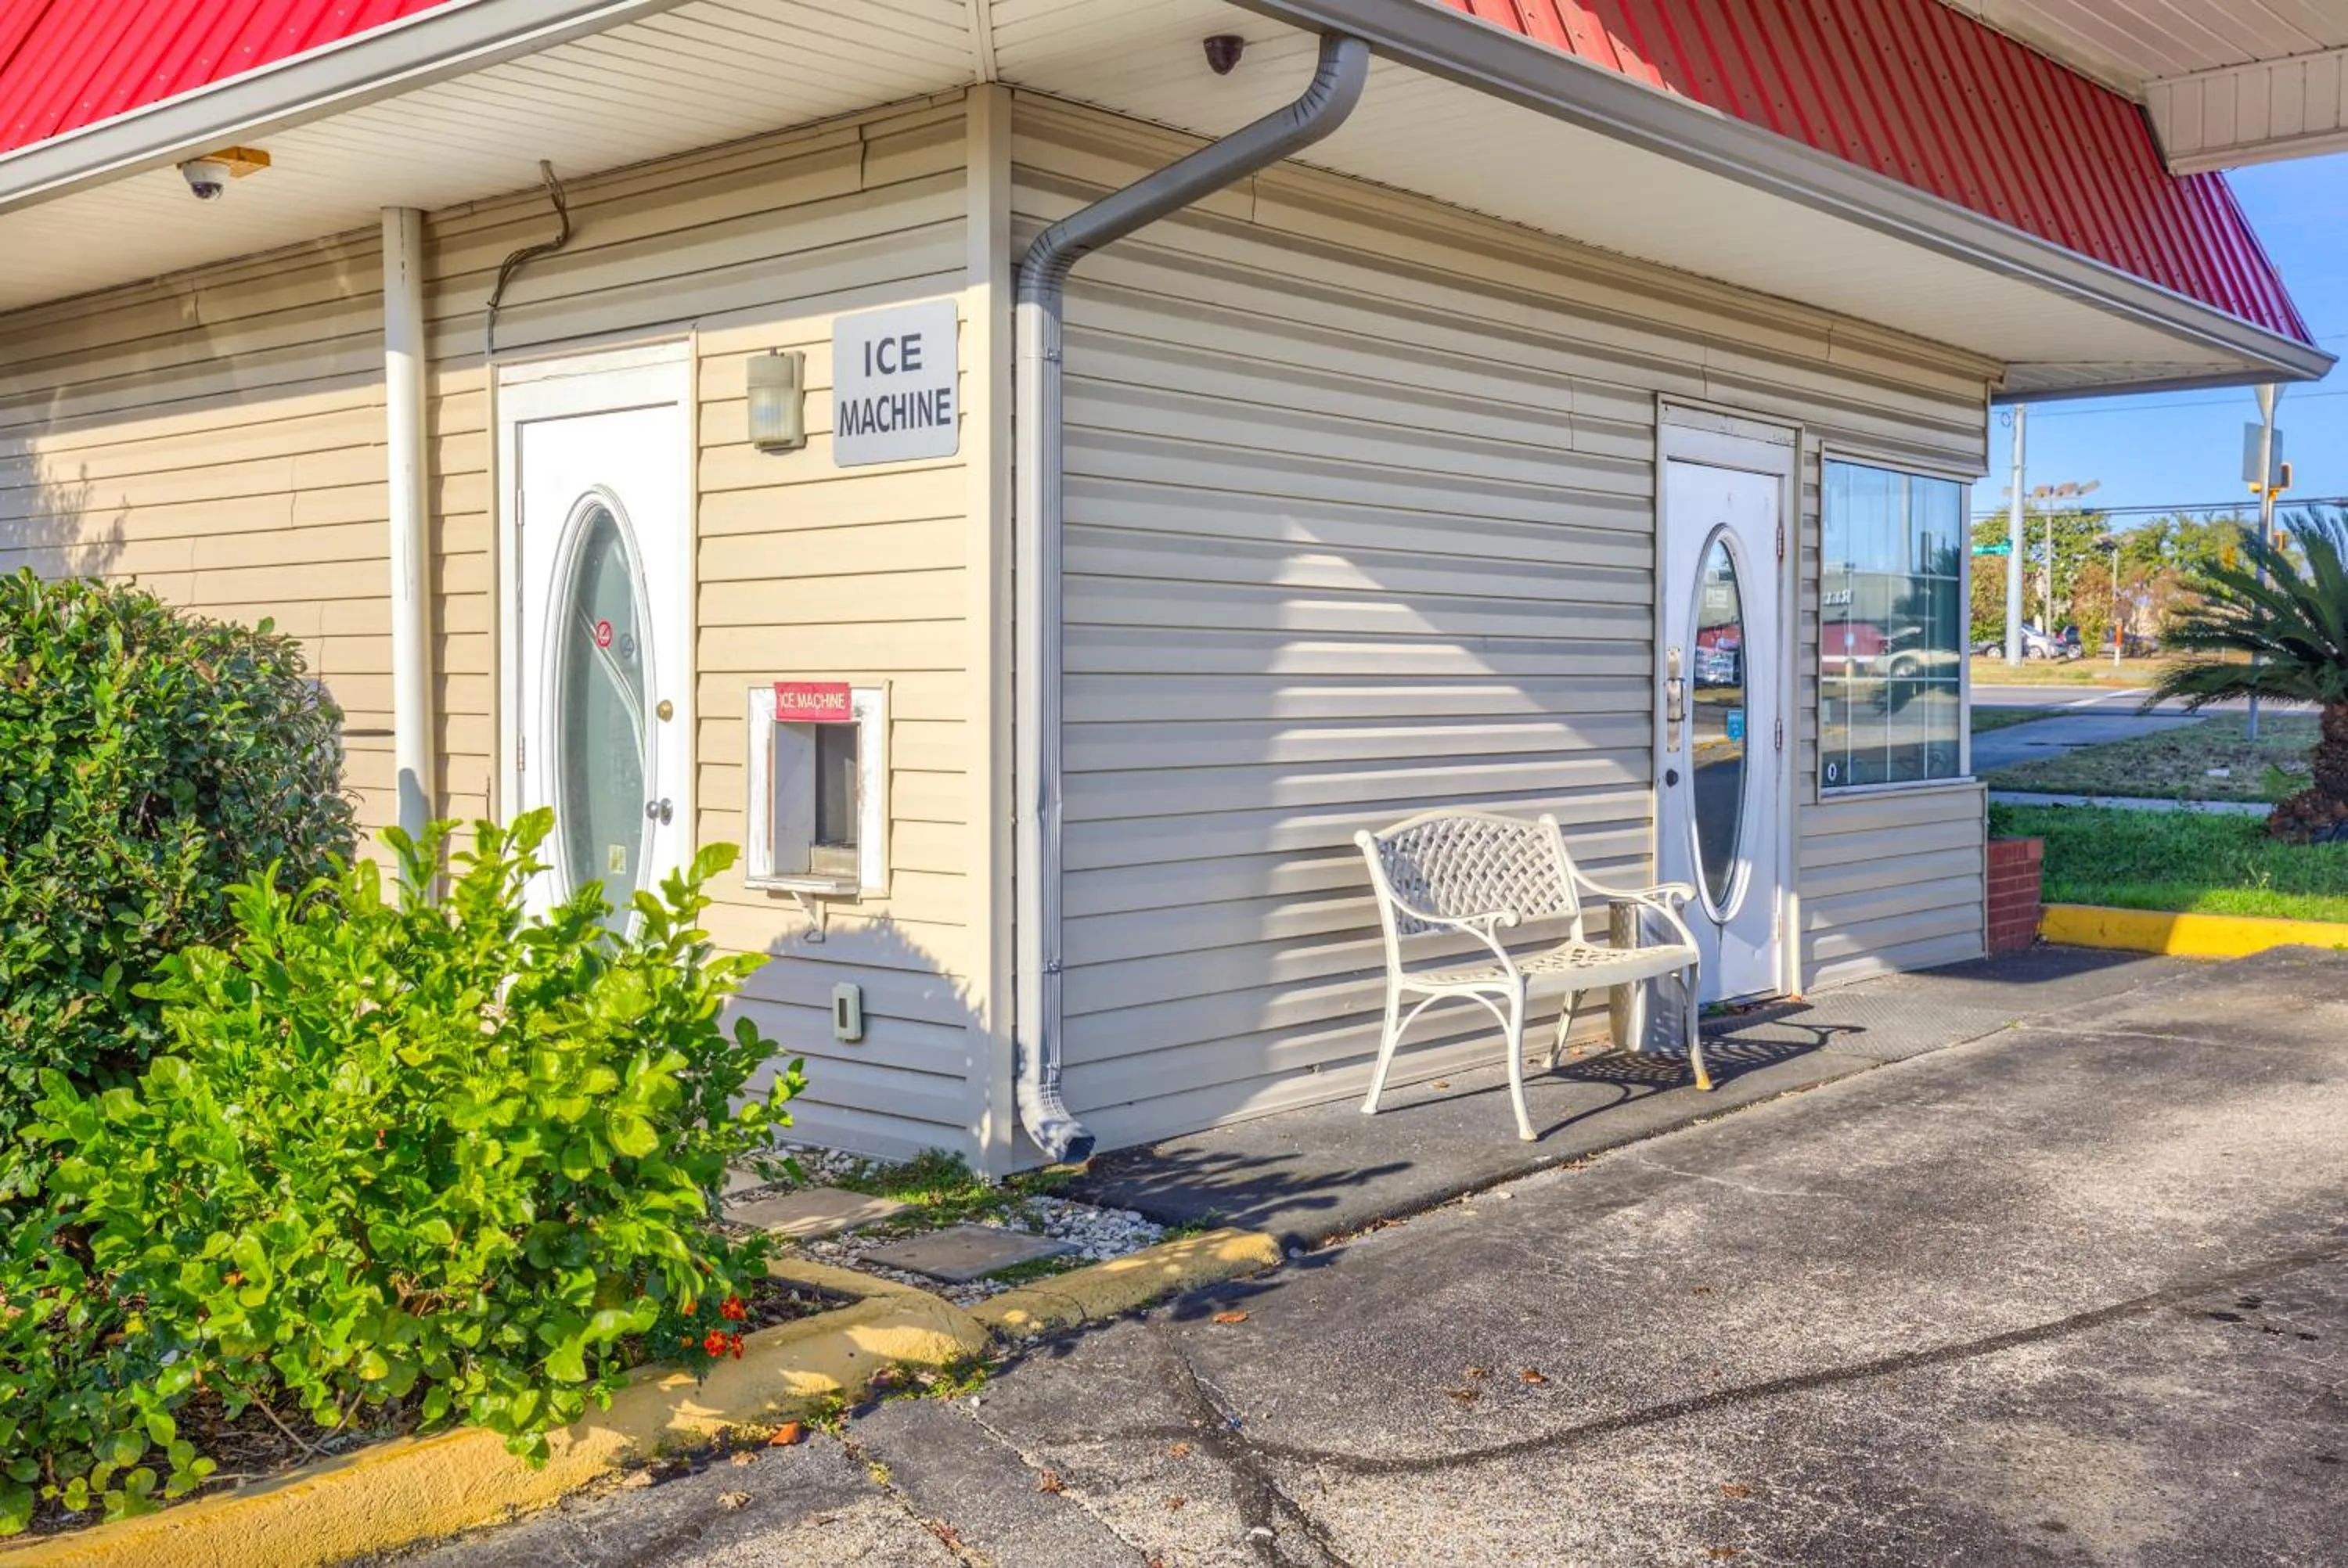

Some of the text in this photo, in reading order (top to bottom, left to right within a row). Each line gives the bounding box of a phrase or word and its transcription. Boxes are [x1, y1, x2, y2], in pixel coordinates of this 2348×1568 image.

[865, 333, 922, 377] ICE
[839, 388, 951, 437] MACHINE
[798, 693, 845, 710] MACHINE
